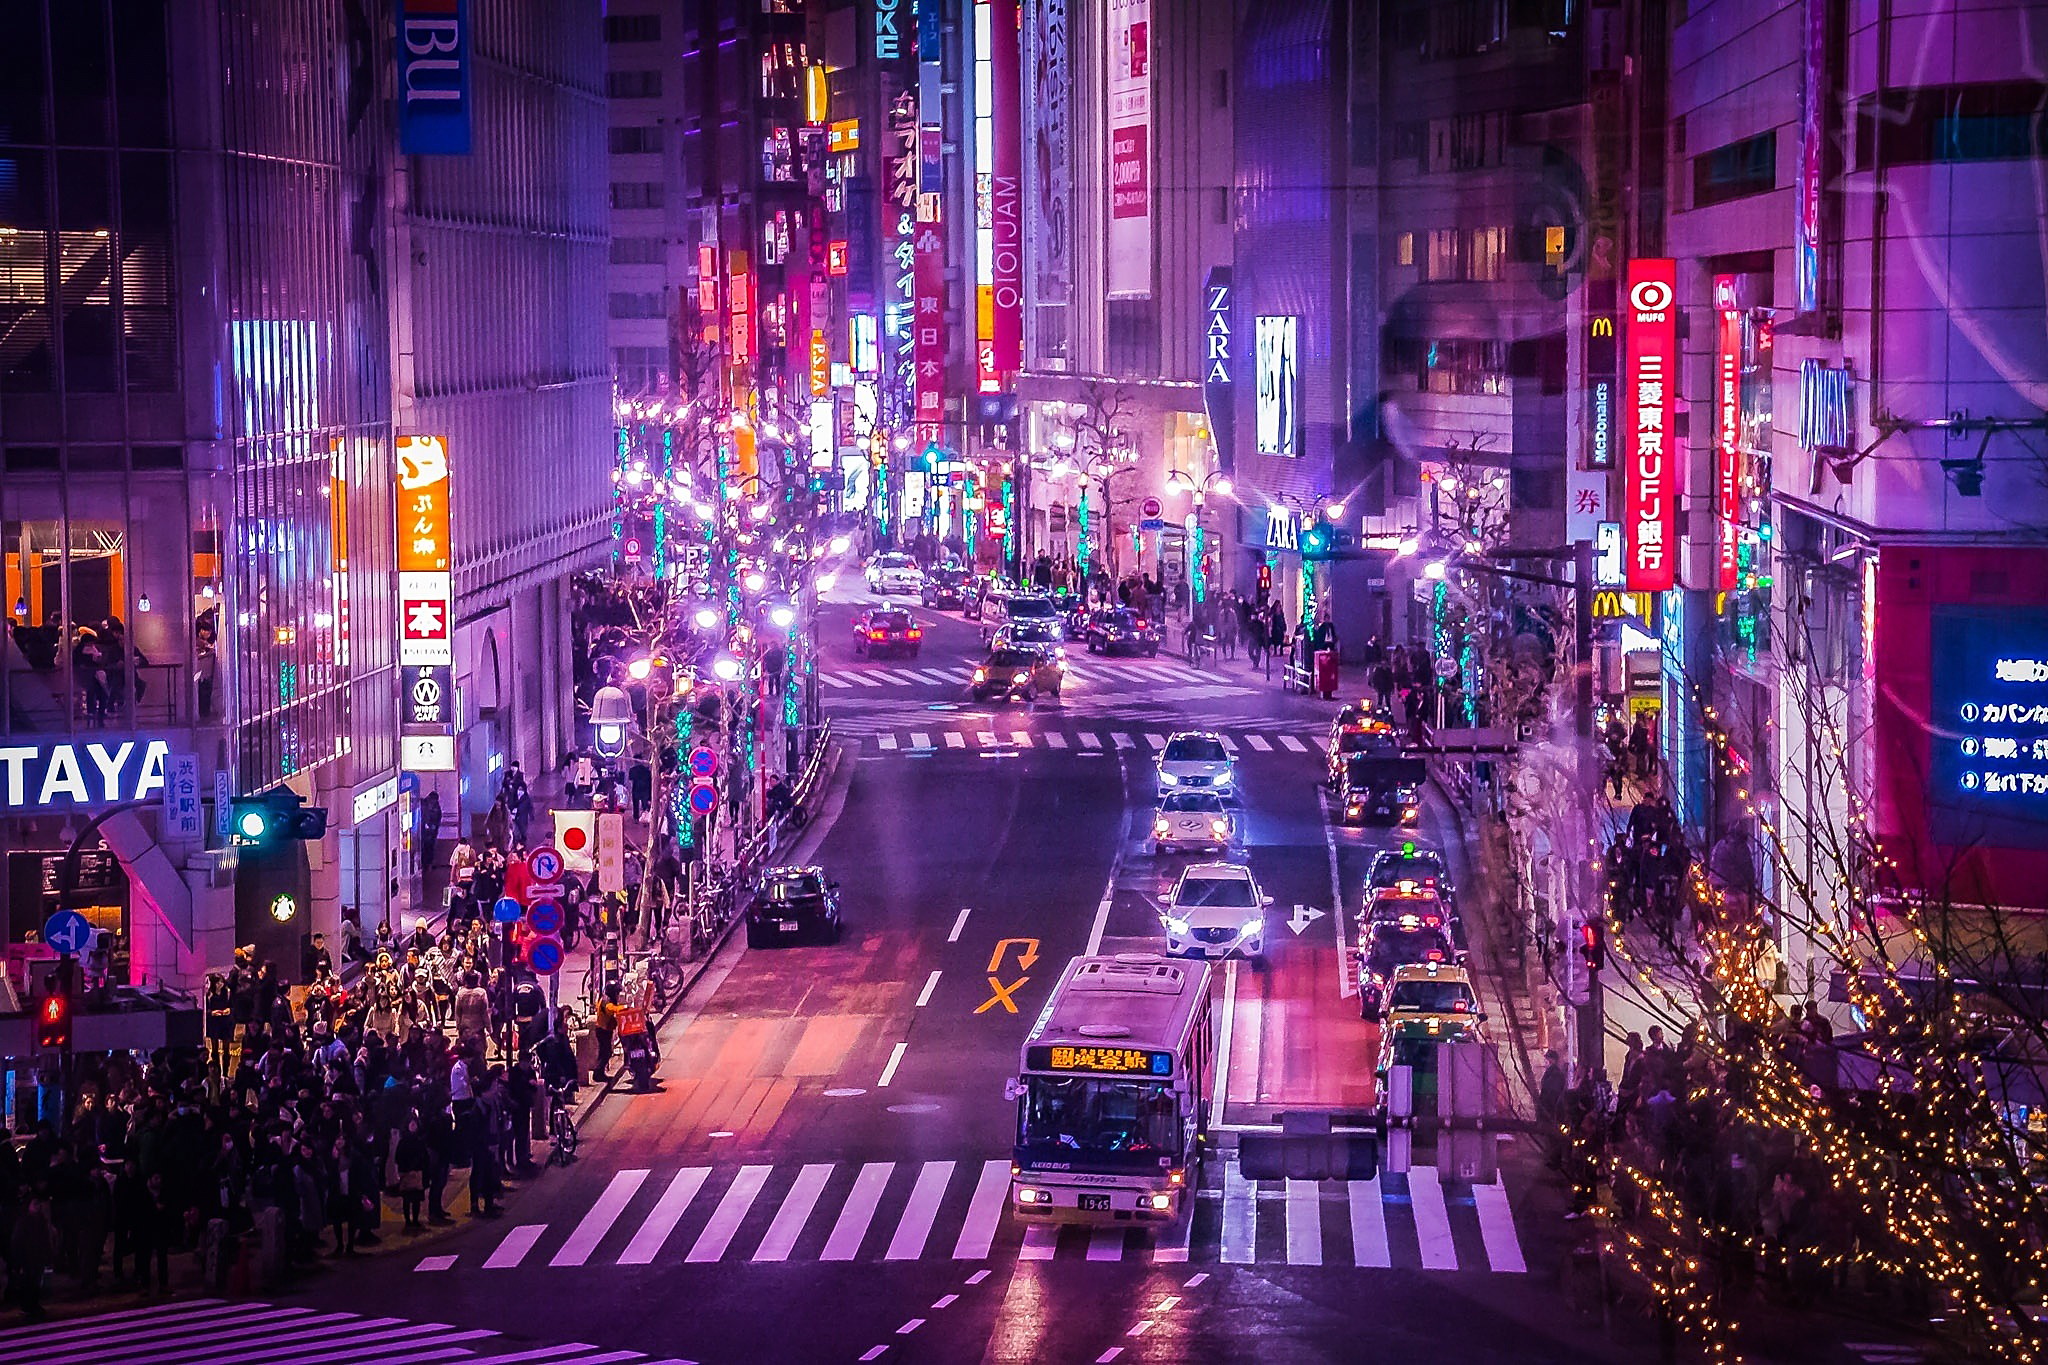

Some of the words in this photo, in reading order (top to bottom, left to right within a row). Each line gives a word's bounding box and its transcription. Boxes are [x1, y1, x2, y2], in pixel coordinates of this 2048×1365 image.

[1207, 287, 1231, 382] ZARA
[920, 297, 940, 441] 東日本銀行
[1595, 383, 1608, 463] McDonald's
[1637, 356, 1663, 569] 三菱東京UFJ銀行
[1576, 489, 1600, 514] 券
[1265, 510, 1298, 550] ZARA
[408, 602, 442, 637] 本
[0, 741, 169, 806] TAYA
[179, 760, 197, 832] 渋谷駅前
[1074, 1053, 1147, 1069] 渋谷駅
[1052, 1162, 1071, 1170] BUS
[1084, 1199, 1110, 1210] 19-65
